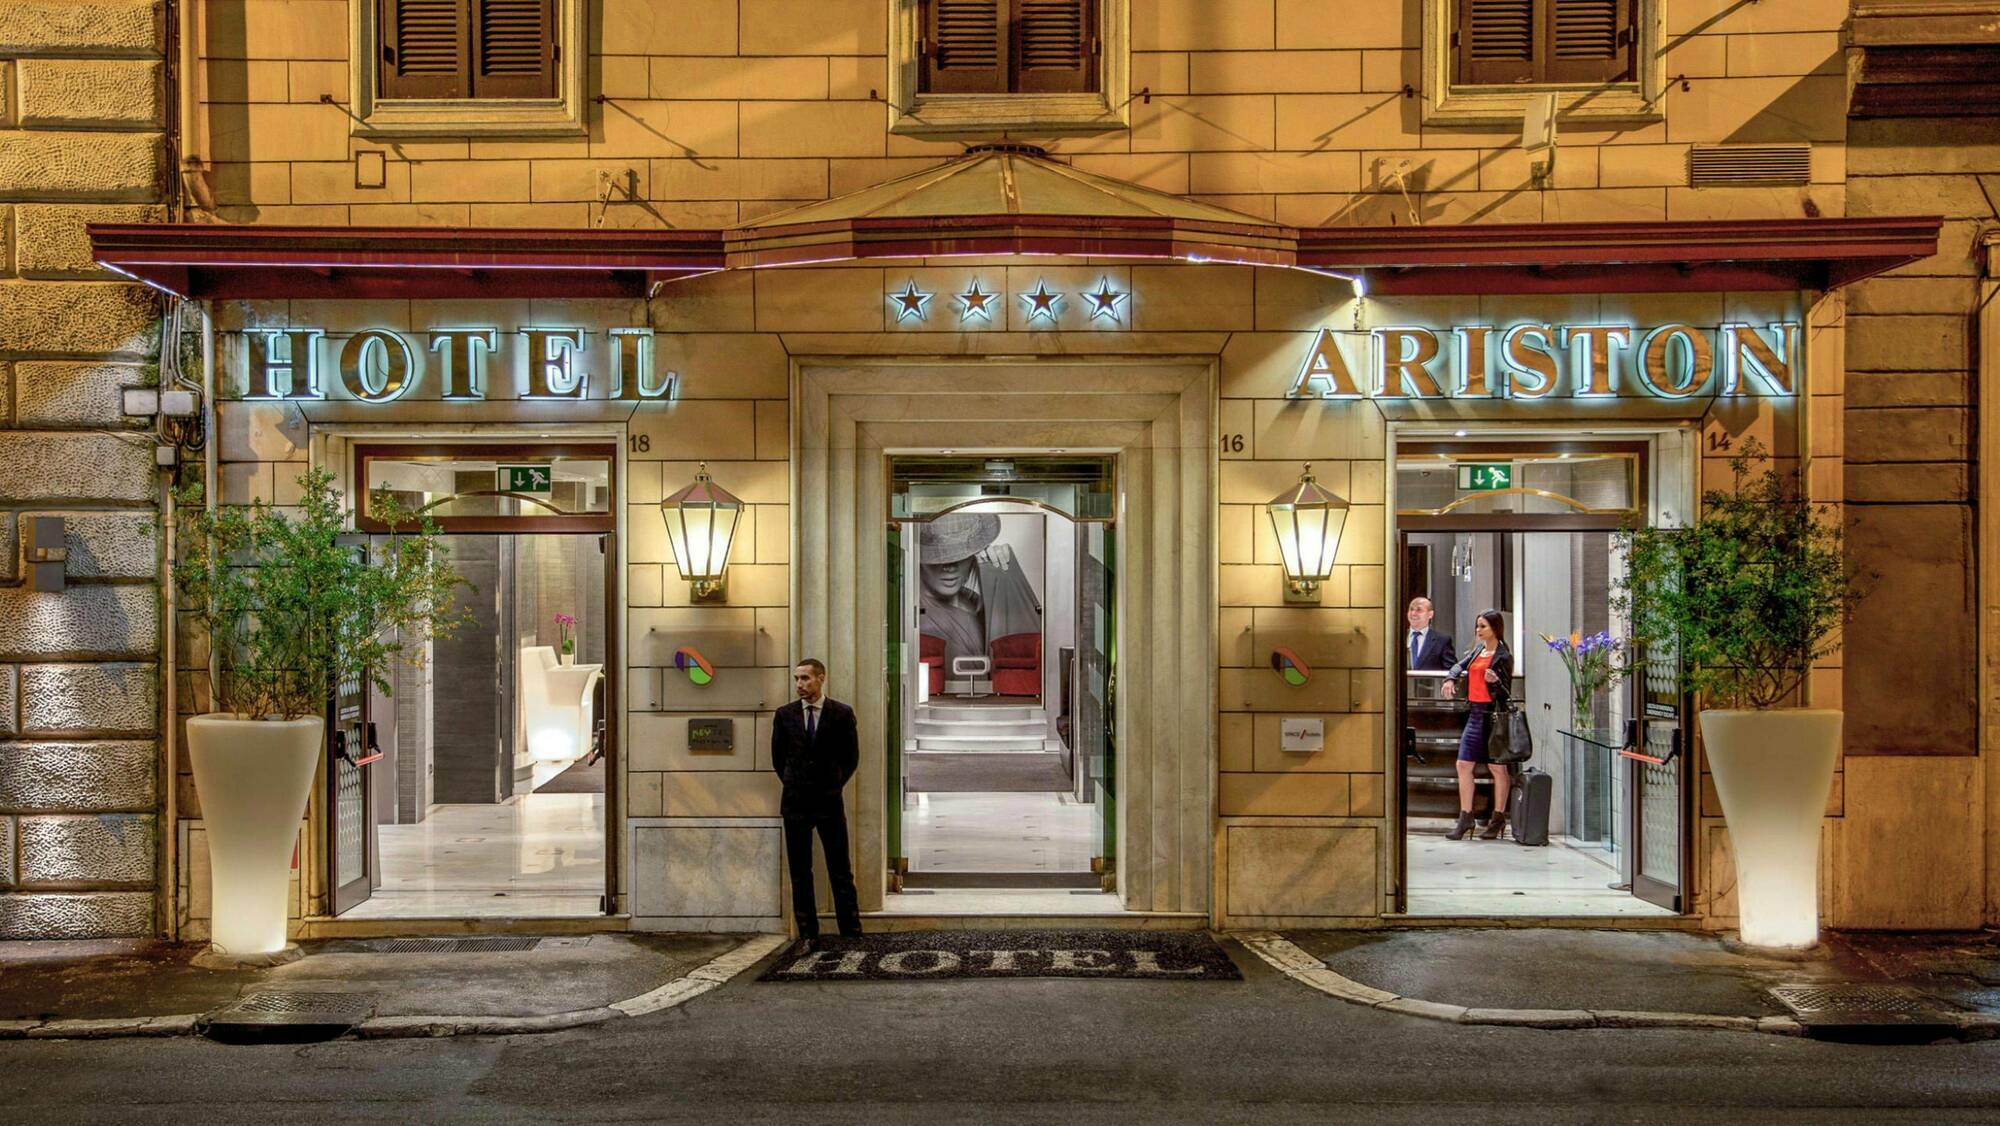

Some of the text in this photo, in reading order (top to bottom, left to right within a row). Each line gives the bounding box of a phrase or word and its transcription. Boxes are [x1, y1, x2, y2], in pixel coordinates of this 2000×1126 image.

[242, 320, 1799, 403] HOTEL ARISTON
[630, 434, 650, 453] 18
[1221, 434, 1244, 453] 16
[1707, 431, 1733, 451] 14
[776, 949, 1205, 974] HOTEL
